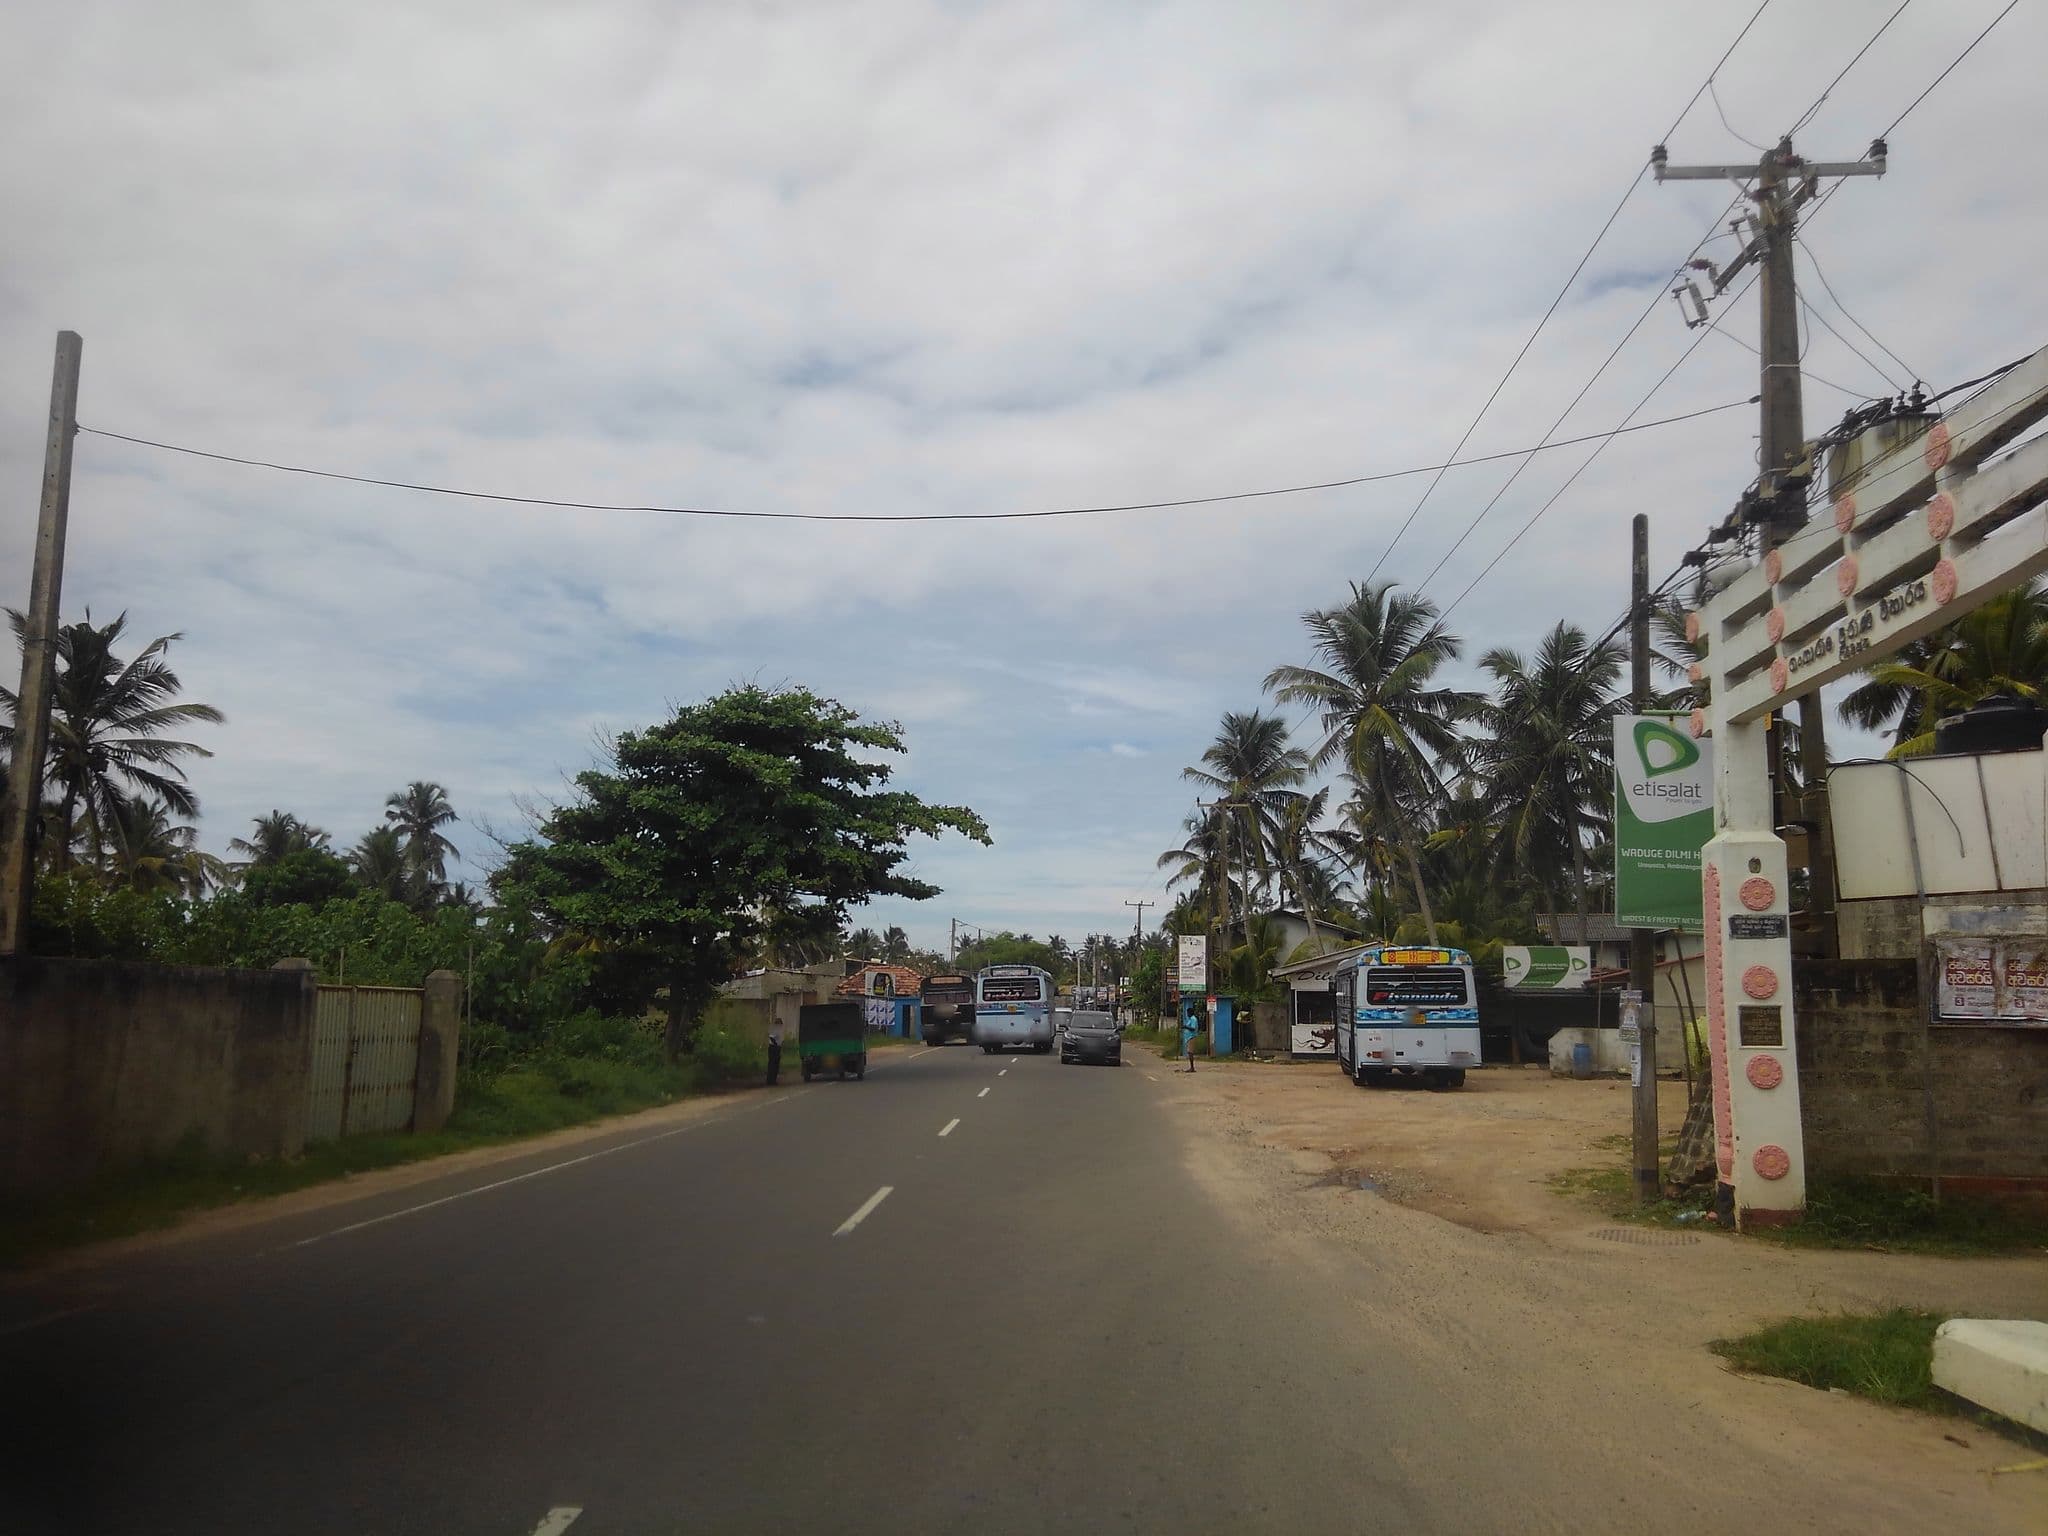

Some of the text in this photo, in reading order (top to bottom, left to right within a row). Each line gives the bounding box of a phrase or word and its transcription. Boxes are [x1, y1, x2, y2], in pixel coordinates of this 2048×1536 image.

[1632, 781, 1702, 798] etisalat
[1621, 848, 1702, 860] WADUGE DILMI H
[2008, 973, 2048, 988] අවසර
